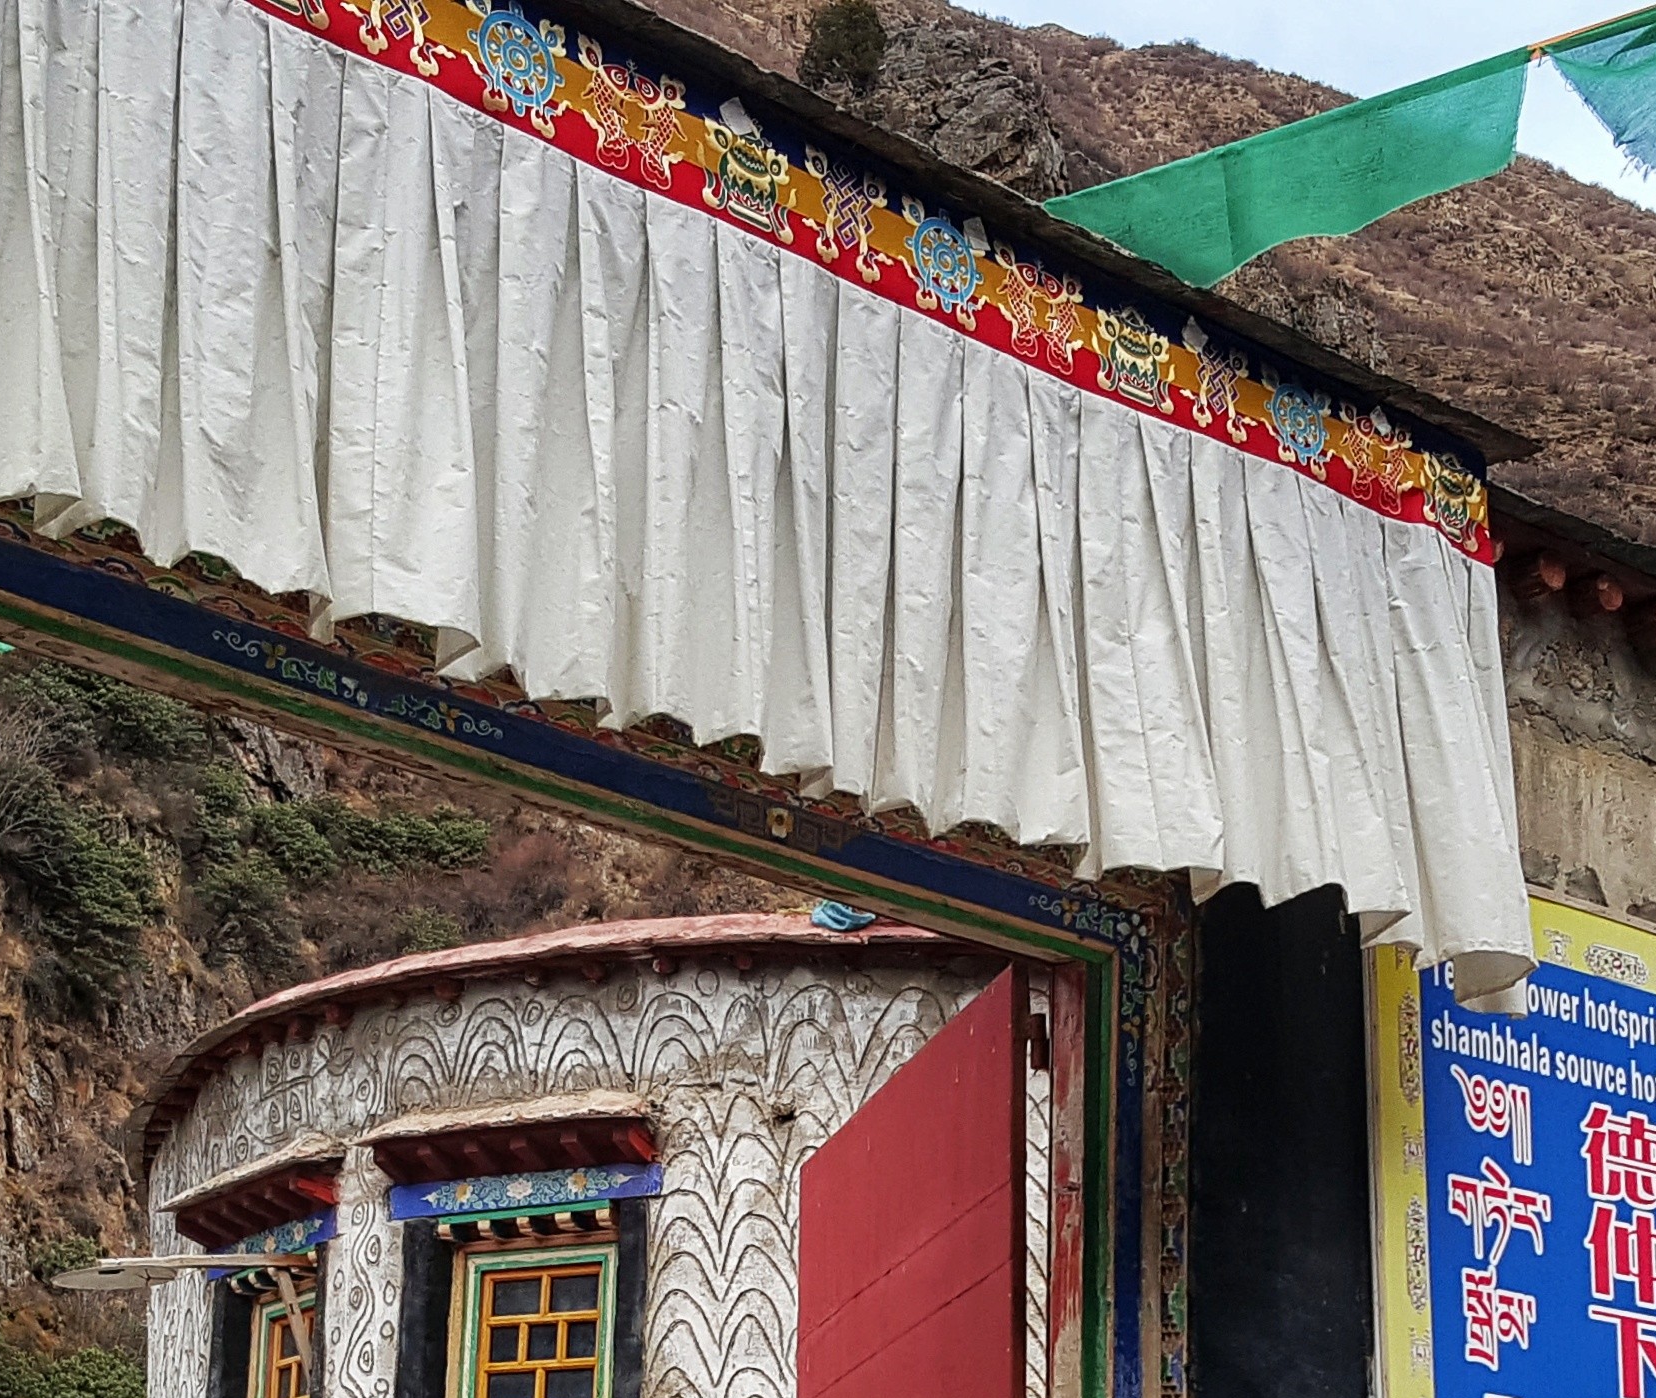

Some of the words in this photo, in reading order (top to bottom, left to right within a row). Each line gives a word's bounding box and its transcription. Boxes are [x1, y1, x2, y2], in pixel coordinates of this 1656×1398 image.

[1527, 984, 1580, 1023] ower
[1430, 1009, 1551, 1077] shambhala
[1554, 1050, 1628, 1096] souvce
